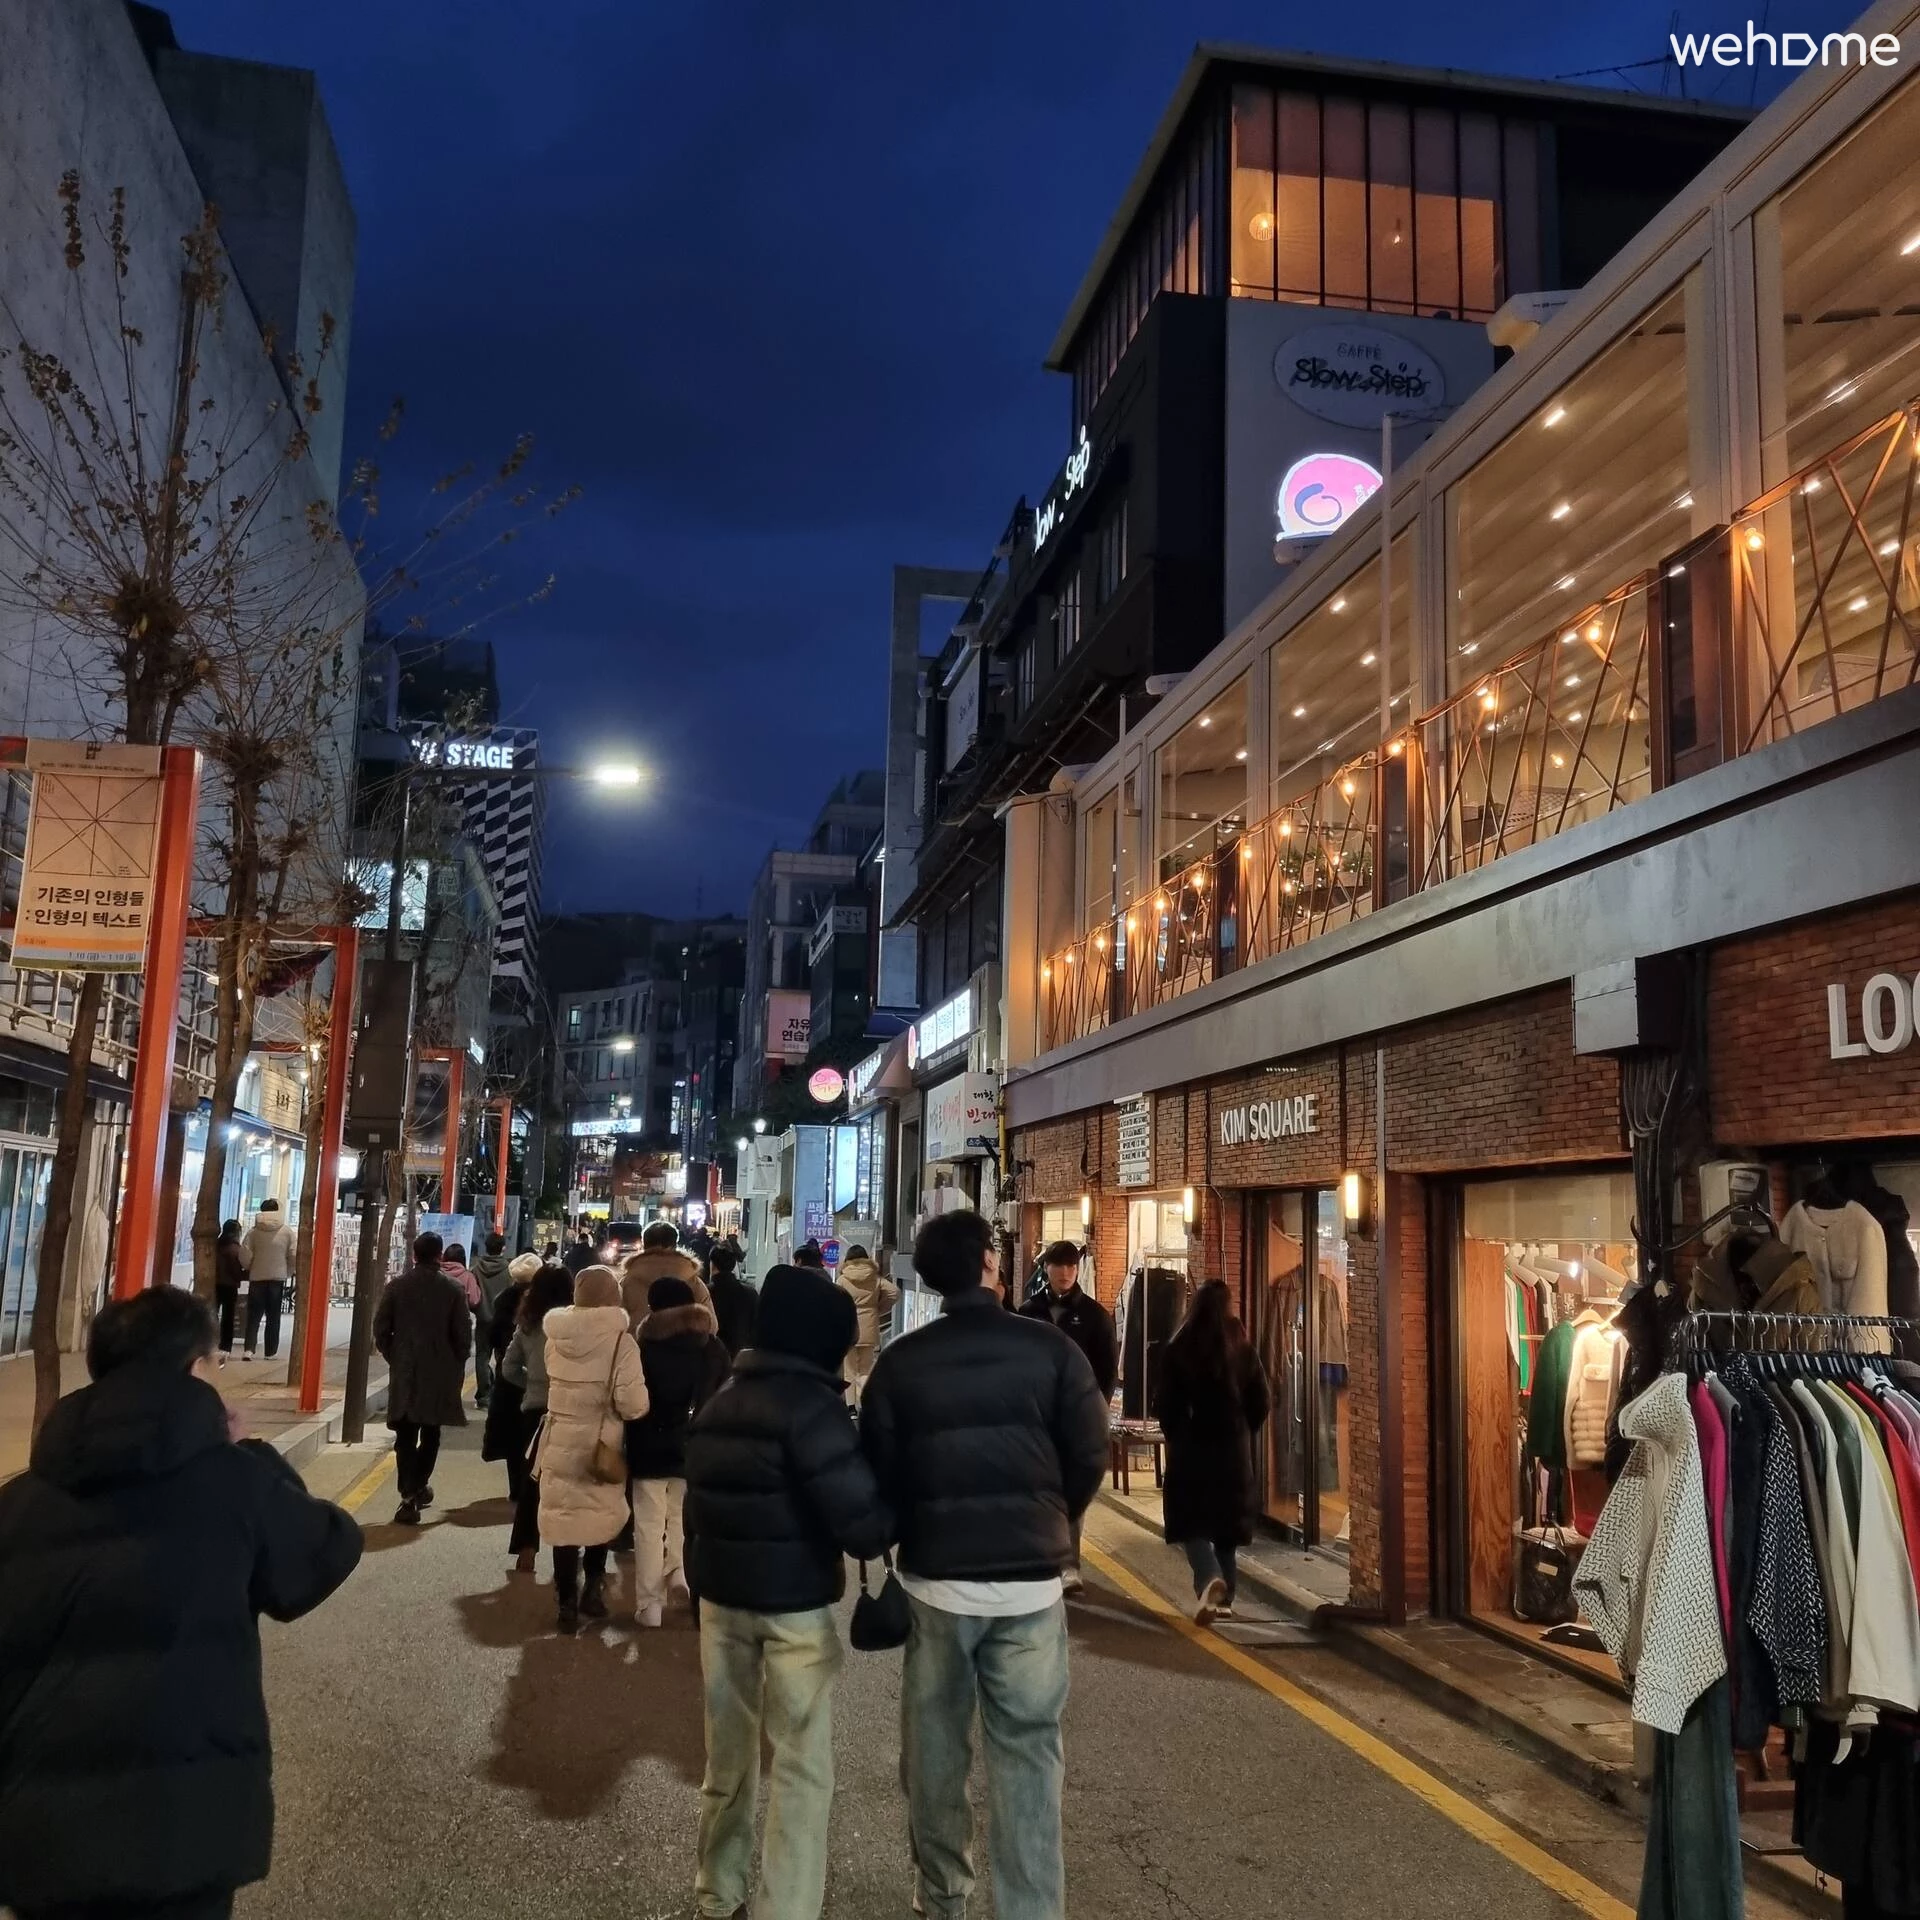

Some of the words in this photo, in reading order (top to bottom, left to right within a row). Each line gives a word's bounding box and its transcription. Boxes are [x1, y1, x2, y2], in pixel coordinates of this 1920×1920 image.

[446, 743, 514, 769] STAGE
[37, 886, 90, 906] 기존의
[94, 889, 145, 908] 인형들
[92, 911, 142, 929] 텍스트
[1827, 971, 1920, 1059] LO
[966, 1107, 999, 1128] 빈대
[1220, 1106, 1247, 1145] KIM
[1249, 1093, 1320, 1141] SQUARE
